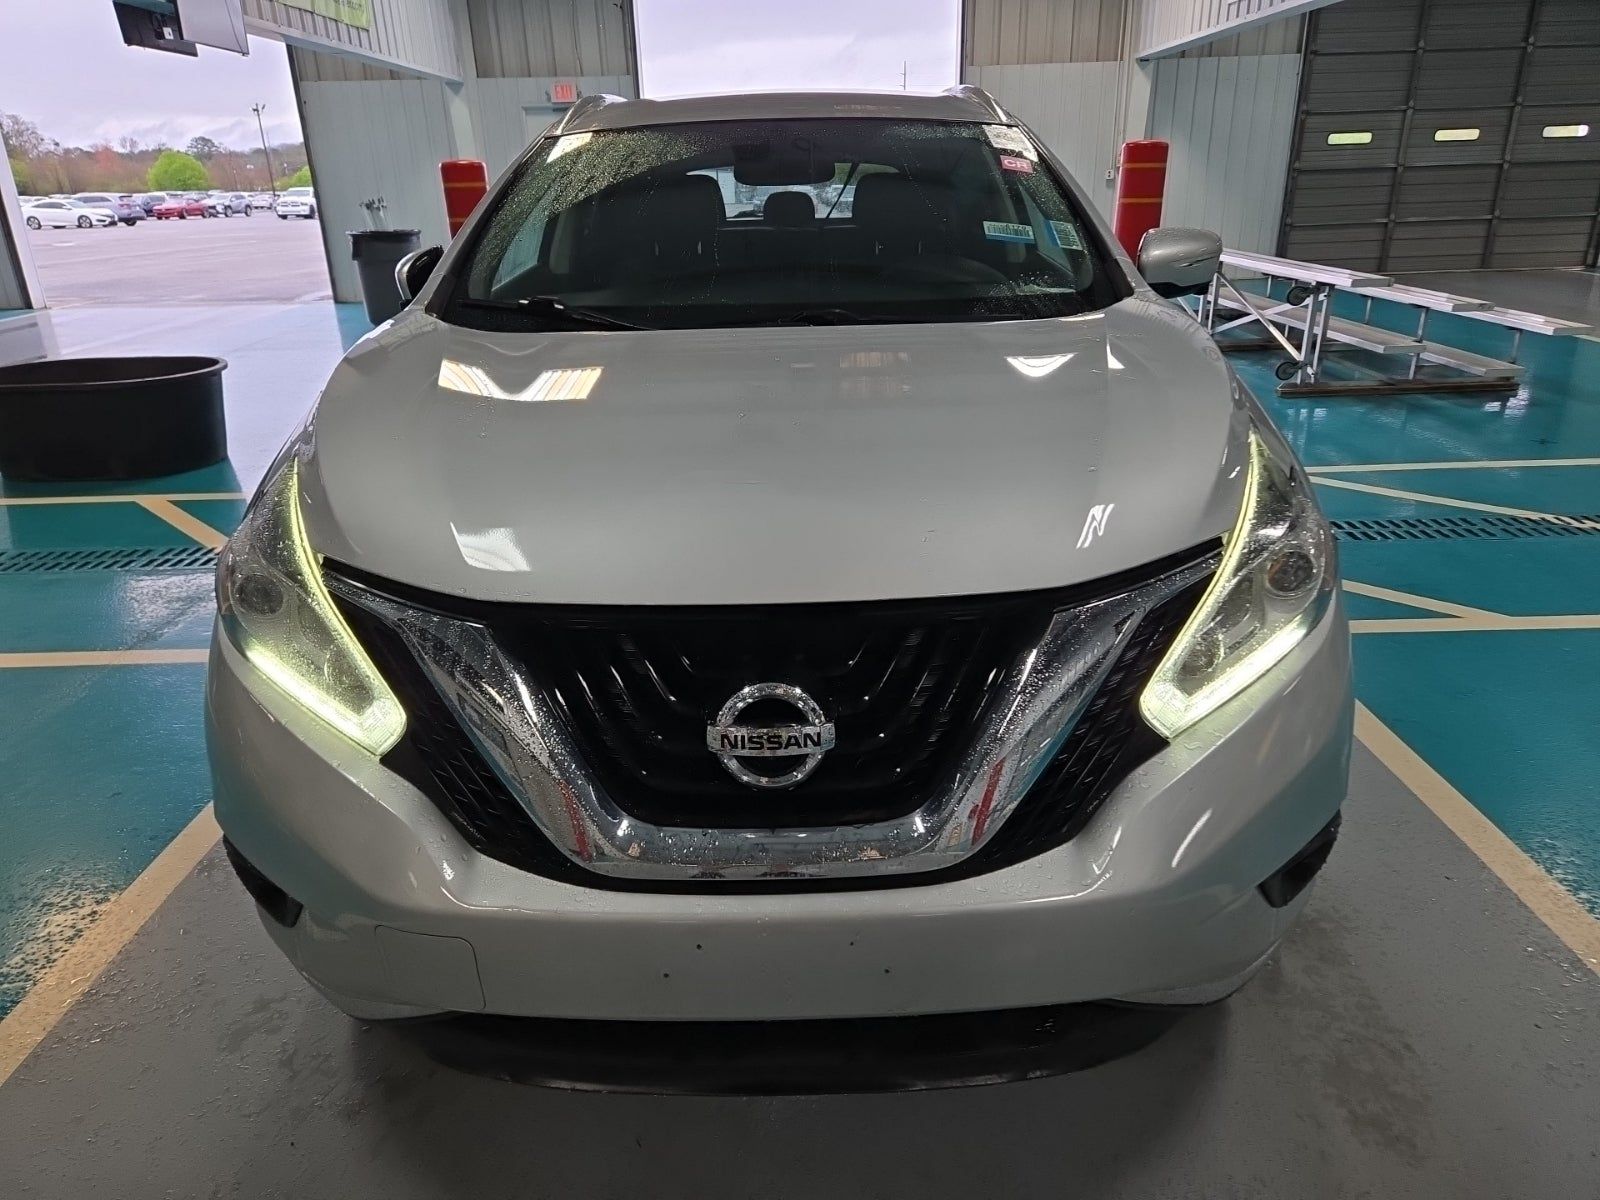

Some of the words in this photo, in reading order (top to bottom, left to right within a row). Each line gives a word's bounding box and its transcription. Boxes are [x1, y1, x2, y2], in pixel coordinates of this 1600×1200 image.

[554, 84, 573, 99] EXIT
[1003, 159, 1028, 170] CR
[720, 732, 821, 751] NISSAN
